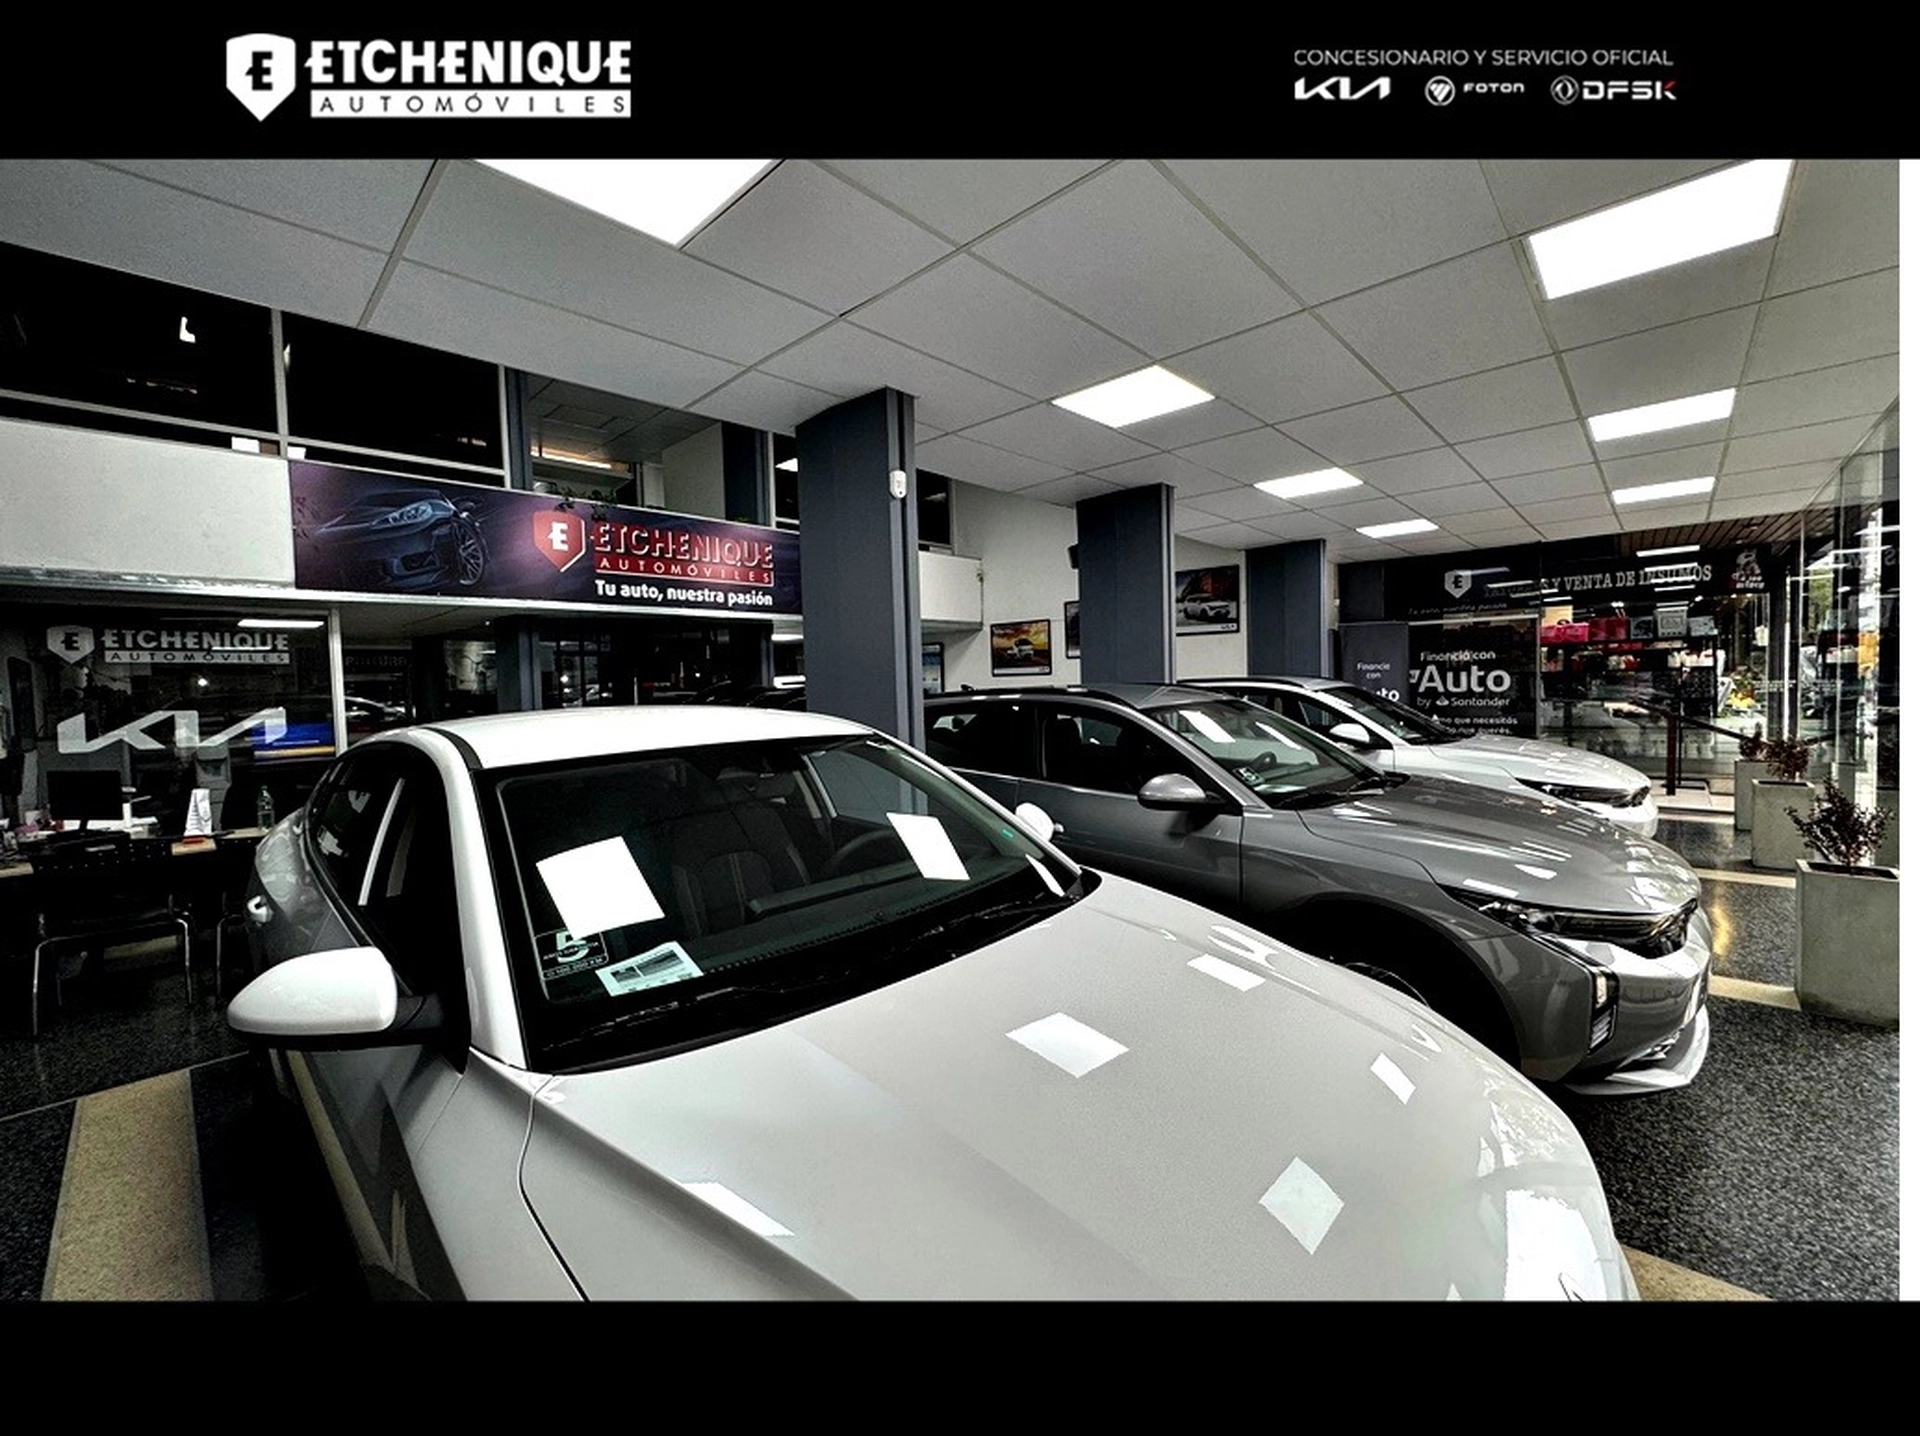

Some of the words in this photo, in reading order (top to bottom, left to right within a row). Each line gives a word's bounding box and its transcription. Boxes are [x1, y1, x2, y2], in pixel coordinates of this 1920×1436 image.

[590, 522, 774, 569] ETCHENIQUE
[600, 557, 770, 584] AUTOMÓVILES
[1563, 572, 1614, 590] VENTA
[1615, 570, 1636, 587] DE
[595, 579, 616, 596] Tu
[620, 582, 664, 601] auto,
[667, 586, 725, 603] nuestra
[728, 590, 773, 607] pasión
[100, 629, 289, 651] ETCHENIQUE
[110, 651, 285, 663] AUTOMÓVILES
[1472, 650, 1496, 660] con
[1418, 664, 1511, 693] Auto
[1416, 697, 1431, 709] by
[1450, 697, 1511, 707] Santander
[57, 707, 288, 754] KIA
